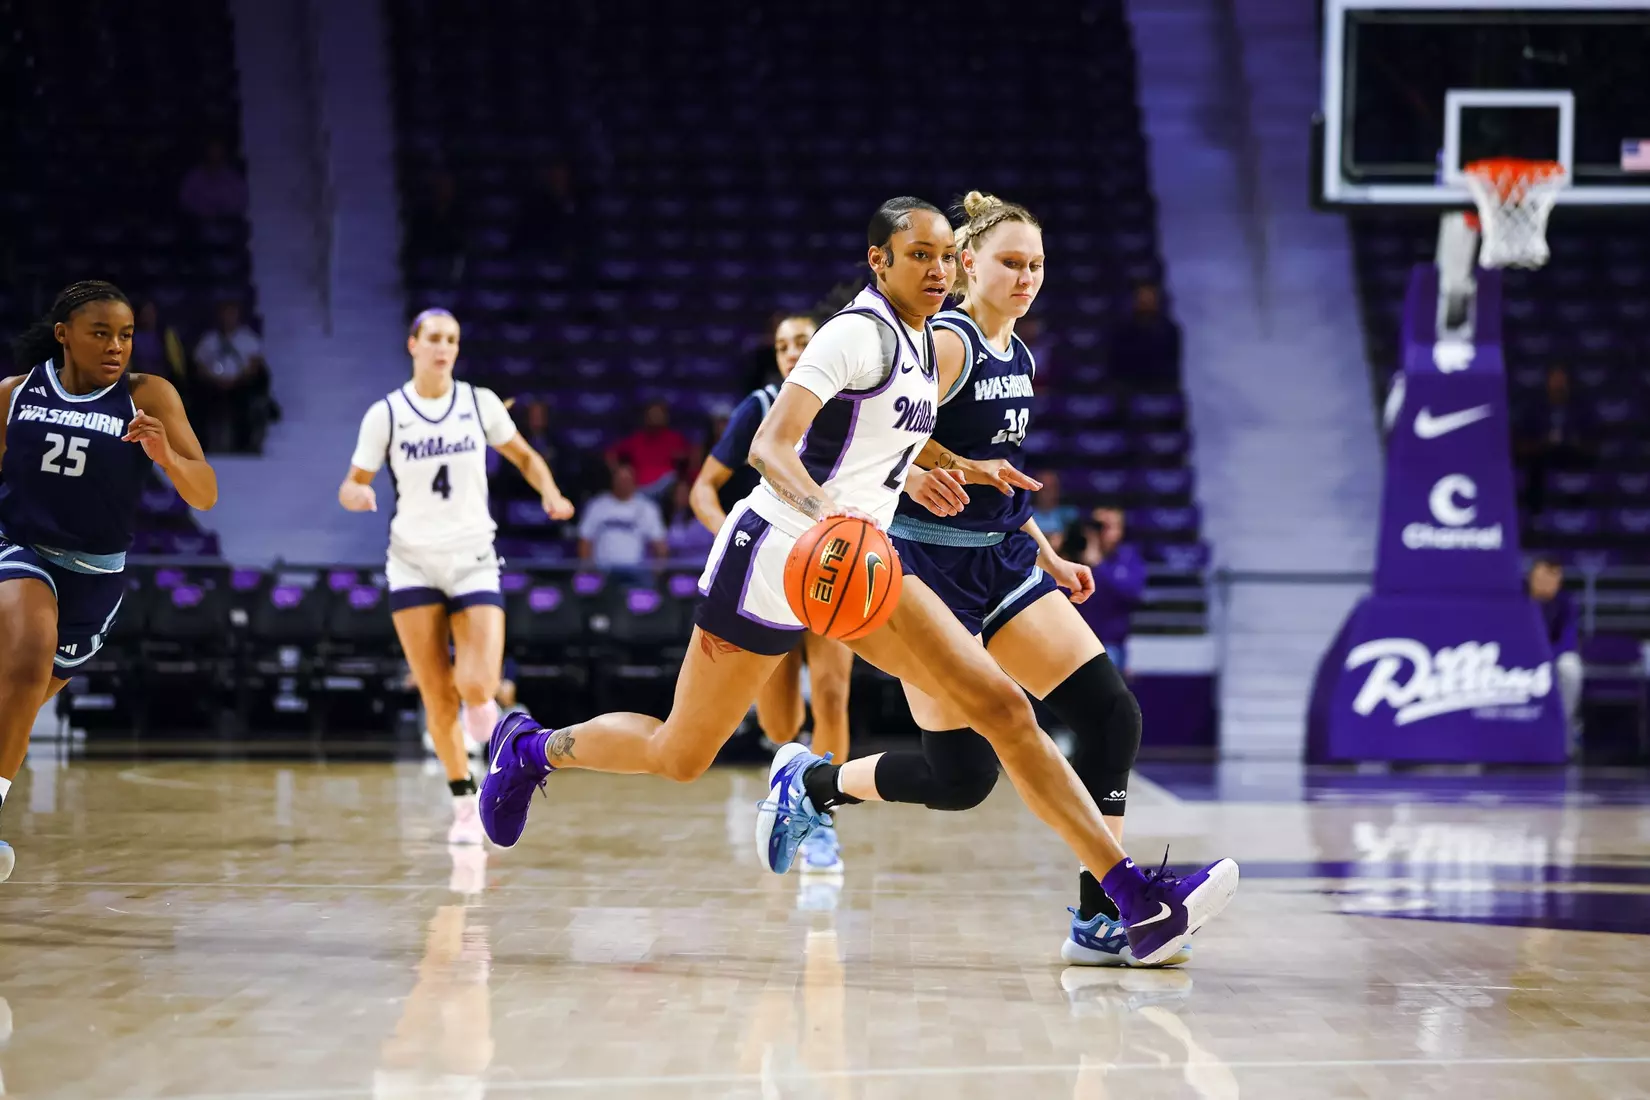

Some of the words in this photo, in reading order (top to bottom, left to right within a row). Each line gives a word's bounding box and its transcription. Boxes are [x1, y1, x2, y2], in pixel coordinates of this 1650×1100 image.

[18, 404, 124, 437] WASHBURN
[41, 432, 91, 477] 25
[400, 436, 477, 461] Wildcats
[432, 464, 452, 500] 4
[813, 537, 851, 604] ELITE
[1344, 637, 1553, 722] Dillons
